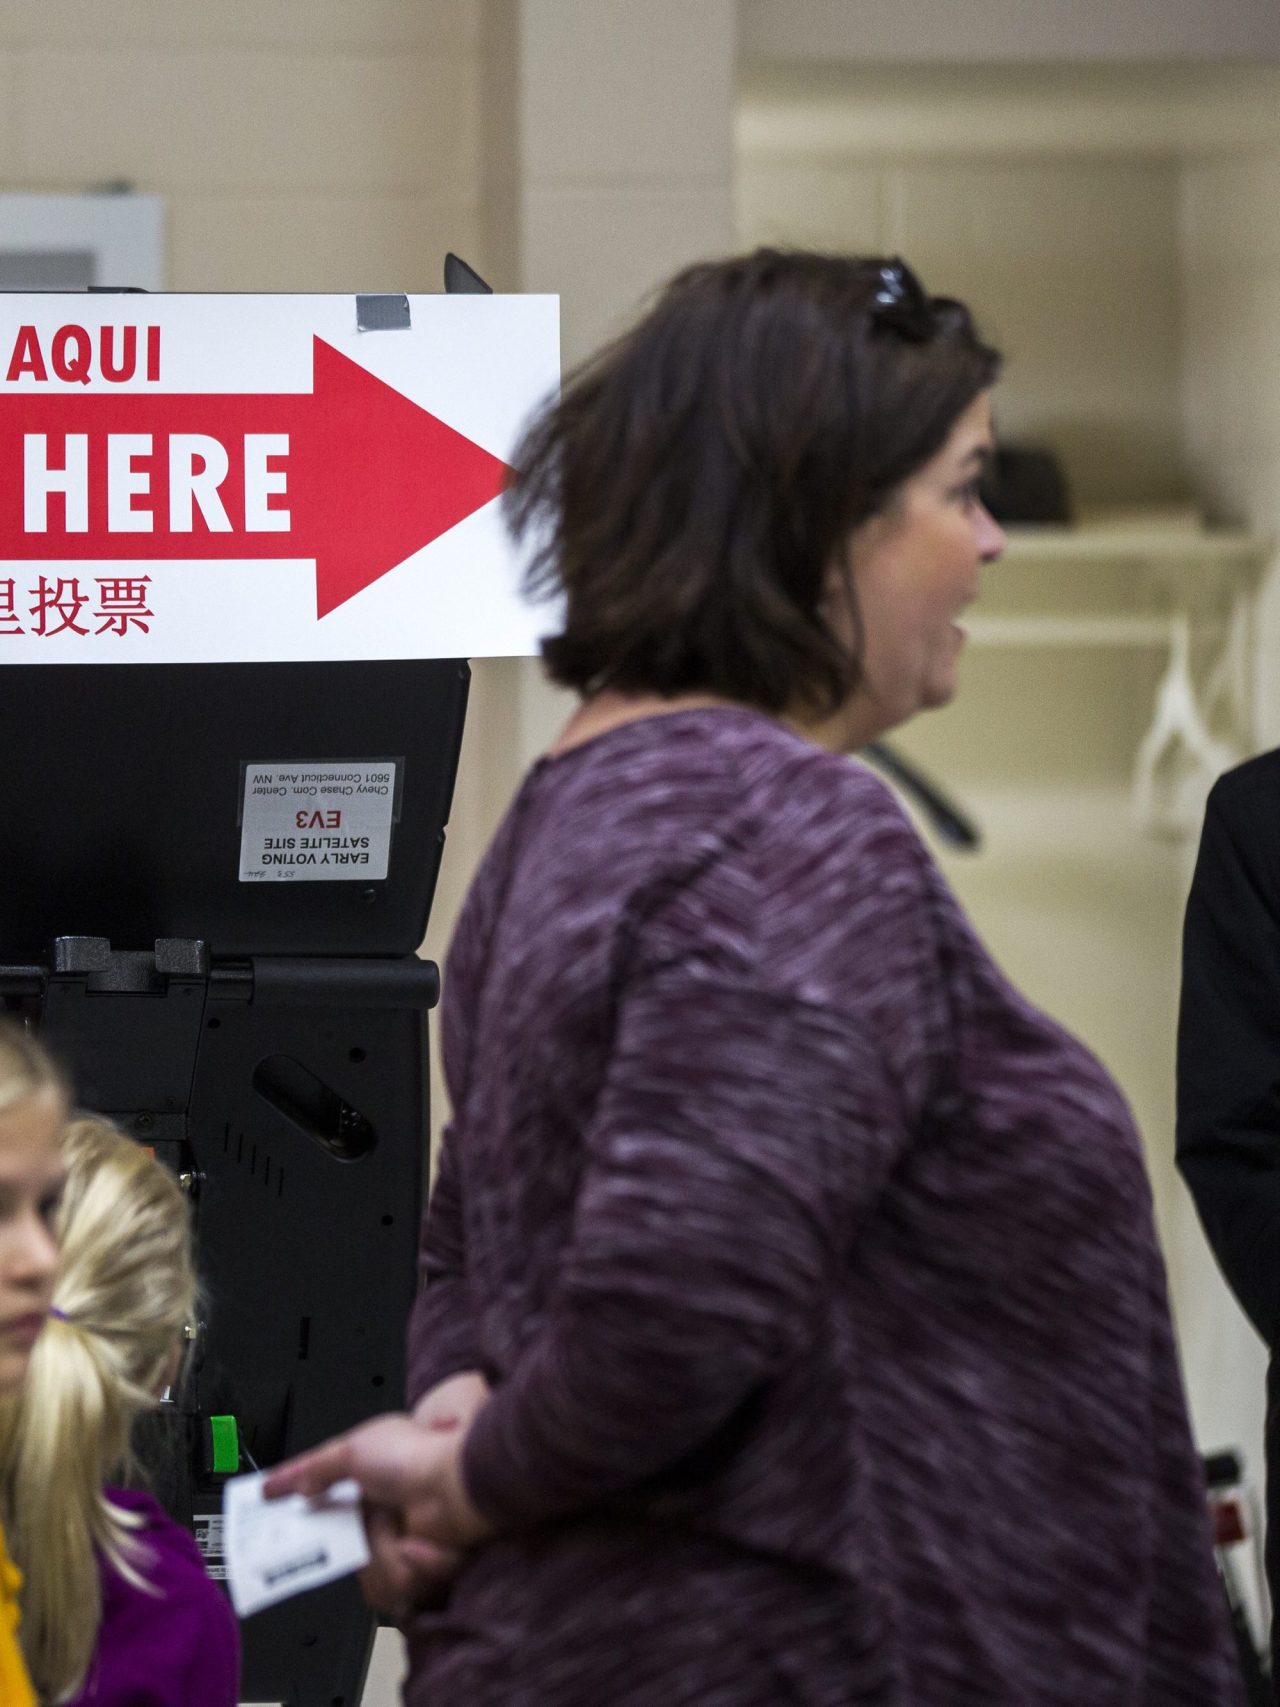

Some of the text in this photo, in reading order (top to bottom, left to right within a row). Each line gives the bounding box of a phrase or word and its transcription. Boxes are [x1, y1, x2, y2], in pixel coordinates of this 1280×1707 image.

[7, 324, 161, 386] AQUI
[24, 433, 291, 533] HERE
[252, 773, 391, 785] 5601 Connecticut Ave. NW
[252, 783, 389, 797] Chevy Chase Com. Center
[295, 809, 342, 829] EV3
[264, 836, 370, 850] SATELITE SITE
[261, 852, 370, 866] EARLY VOTING
